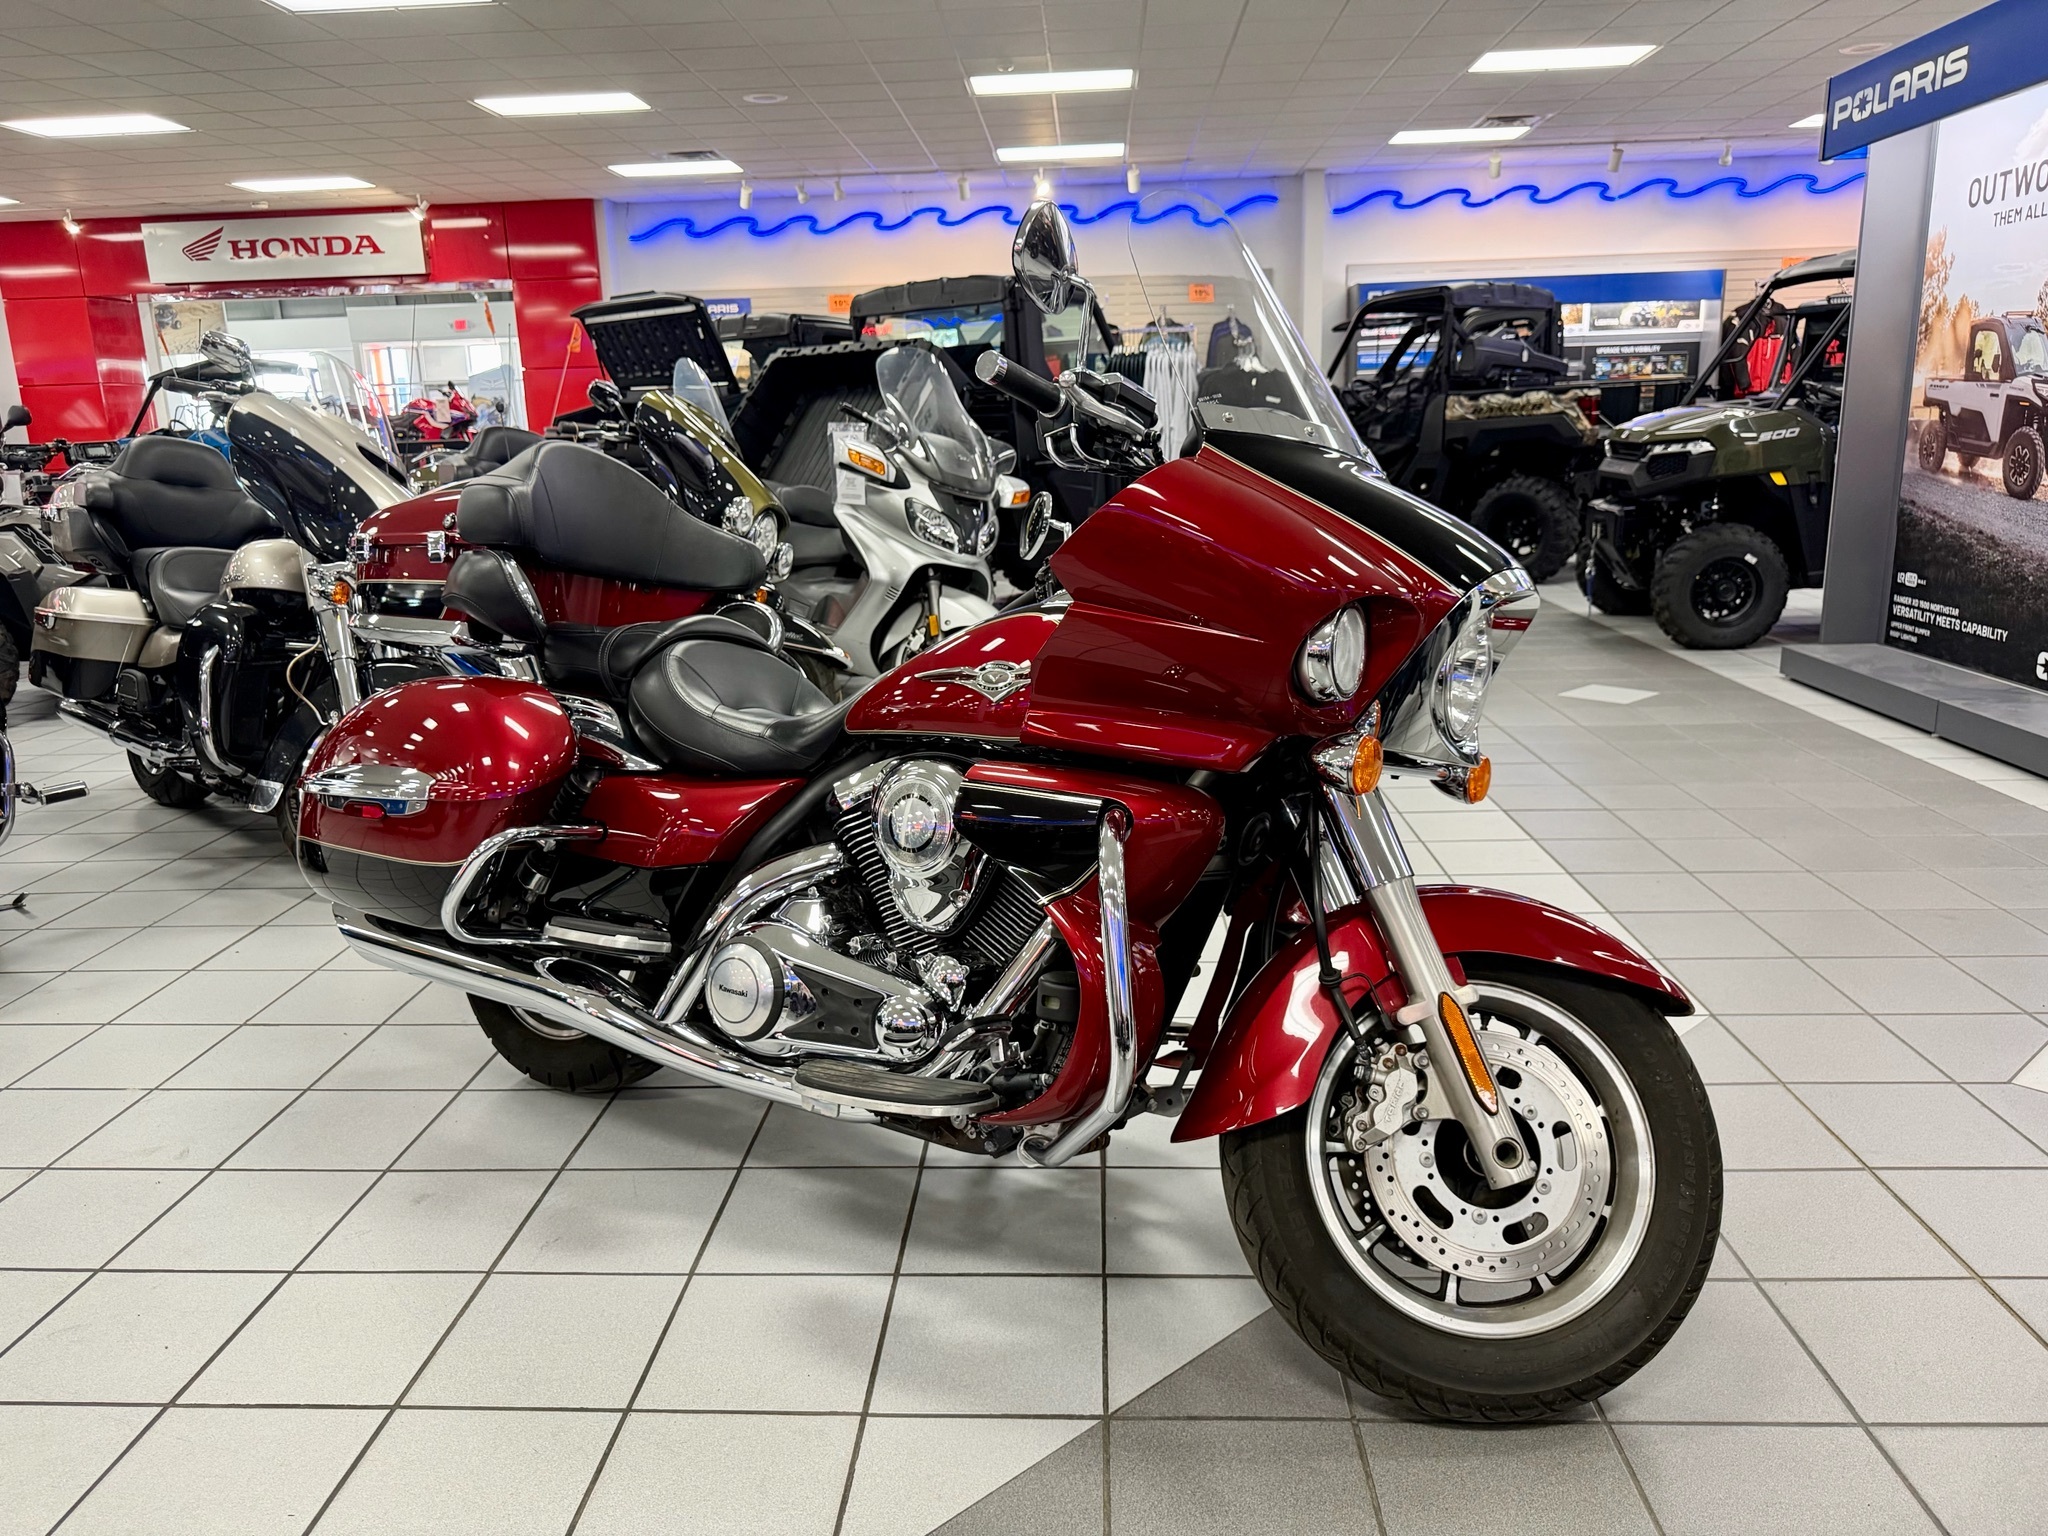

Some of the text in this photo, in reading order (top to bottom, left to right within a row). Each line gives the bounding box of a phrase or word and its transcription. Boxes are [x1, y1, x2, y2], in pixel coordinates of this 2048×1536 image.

[1832, 45, 1969, 131] POLARIS
[1994, 202, 2048, 228] THEM ALL
[227, 234, 386, 260] HONDA
[707, 303, 739, 315] ARIS
[1894, 594, 1912, 606] RANGER
[1930, 603, 1960, 617] NORTHSTAR
[1893, 604, 2009, 643] VERSATILITY MEETS CAPABILITY
[719, 983, 748, 998] Kawasaki
